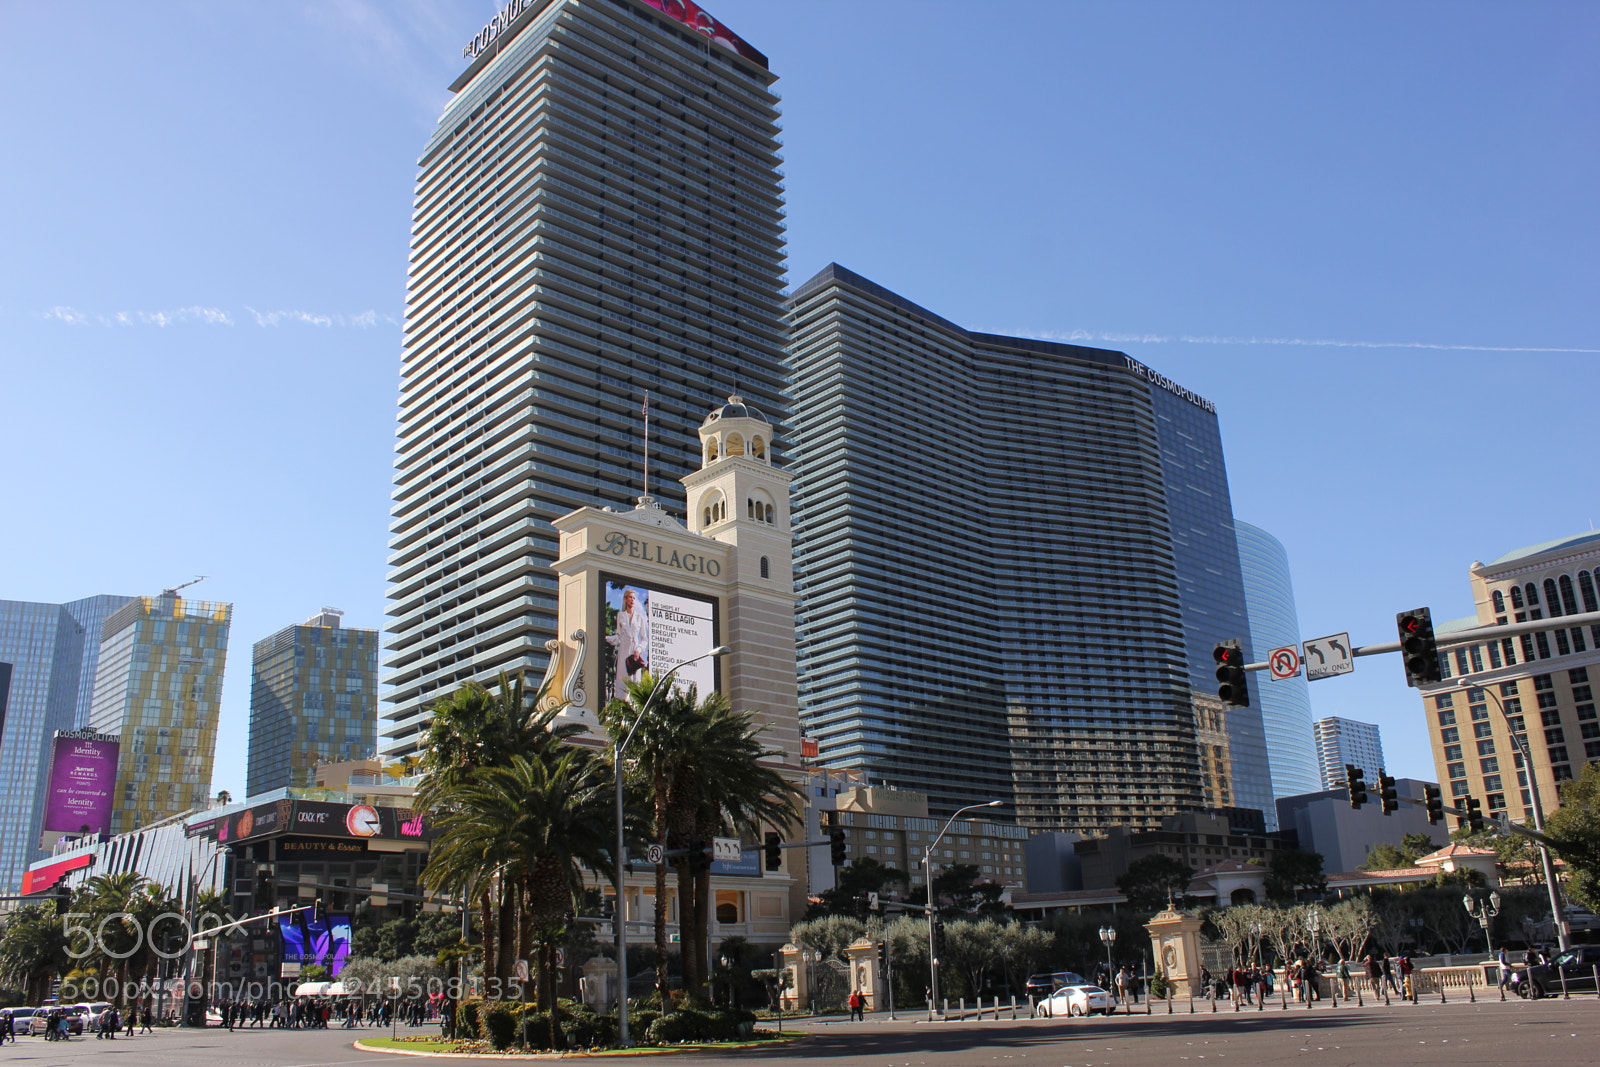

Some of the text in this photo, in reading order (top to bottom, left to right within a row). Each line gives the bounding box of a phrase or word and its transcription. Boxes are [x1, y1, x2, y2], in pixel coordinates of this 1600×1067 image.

[1124, 356, 1217, 413] THE COSMOPOLITAN
[651, 610, 695, 625] VIA BELLAGIO
[651, 622, 698, 636] BOTTEGA VENETA
[651, 629, 677, 638] BREGUET
[651, 635, 674, 644] CHANEL
[651, 648, 669, 656] FENDI
[651, 654, 675, 663] GIORGIO
[651, 660, 669, 669] GUCCI
[1309, 662, 1350, 676] ONLY ONLY
[59, 730, 120, 743] COSMOPOLITAN
[74, 746, 101, 757] Identity
[68, 797, 94, 807] Identity
[284, 842, 327, 850] BEAUTY
